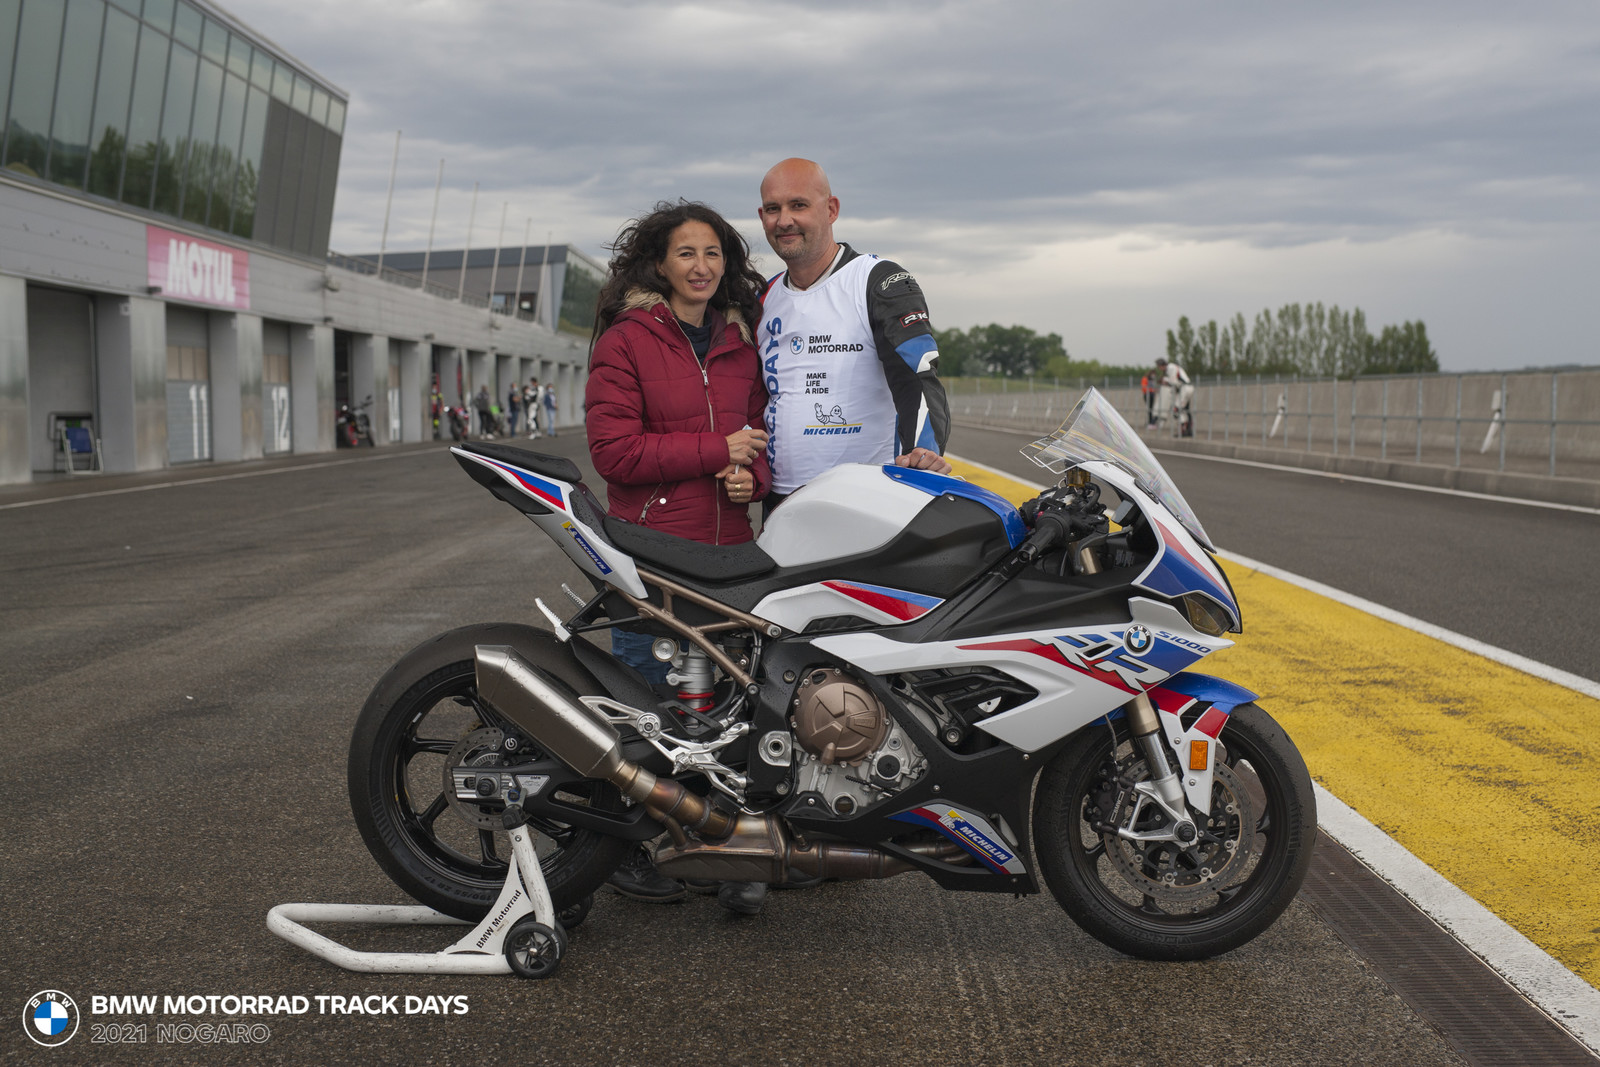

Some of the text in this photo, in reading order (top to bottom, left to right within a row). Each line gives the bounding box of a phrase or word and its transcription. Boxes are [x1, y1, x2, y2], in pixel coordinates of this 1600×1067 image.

[167, 239, 235, 303] MOTUL
[765, 317, 782, 395] DAYS
[808, 344, 864, 354] MOTORRAD
[809, 335, 832, 344] BMW
[189, 384, 209, 459] 11
[272, 386, 290, 451] 12
[803, 426, 862, 435] MICHELIN
[576, 537, 606, 570] MICHELIN
[1156, 630, 1212, 654] S1000
[961, 826, 1008, 861] MICHELIN
[476, 926, 494, 949] BMW
[492, 889, 522, 929] Motorrad
